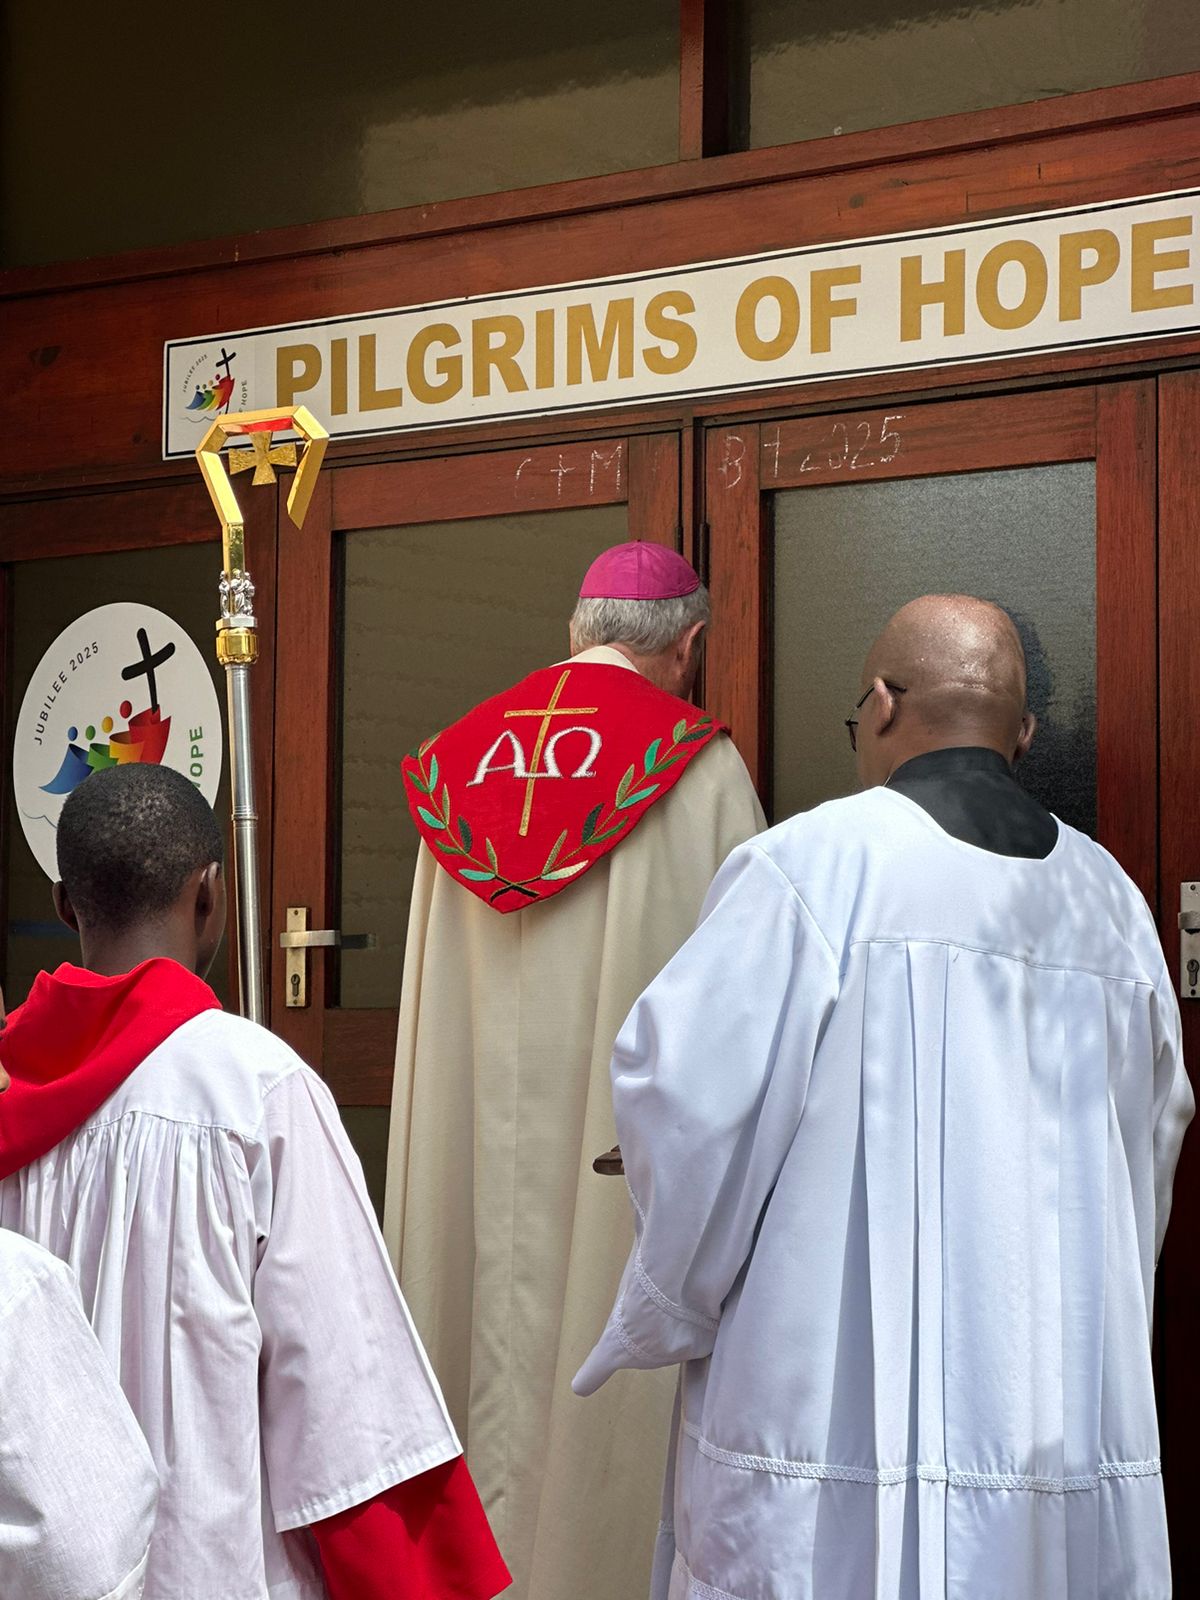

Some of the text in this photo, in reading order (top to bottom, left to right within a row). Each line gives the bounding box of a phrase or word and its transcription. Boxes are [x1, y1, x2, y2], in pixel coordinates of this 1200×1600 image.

[276, 215, 1194, 416] PILGRIMS OF HOPE
[34, 641, 99, 746] JUBILEE 2025
[189, 726, 204, 788] OPE
